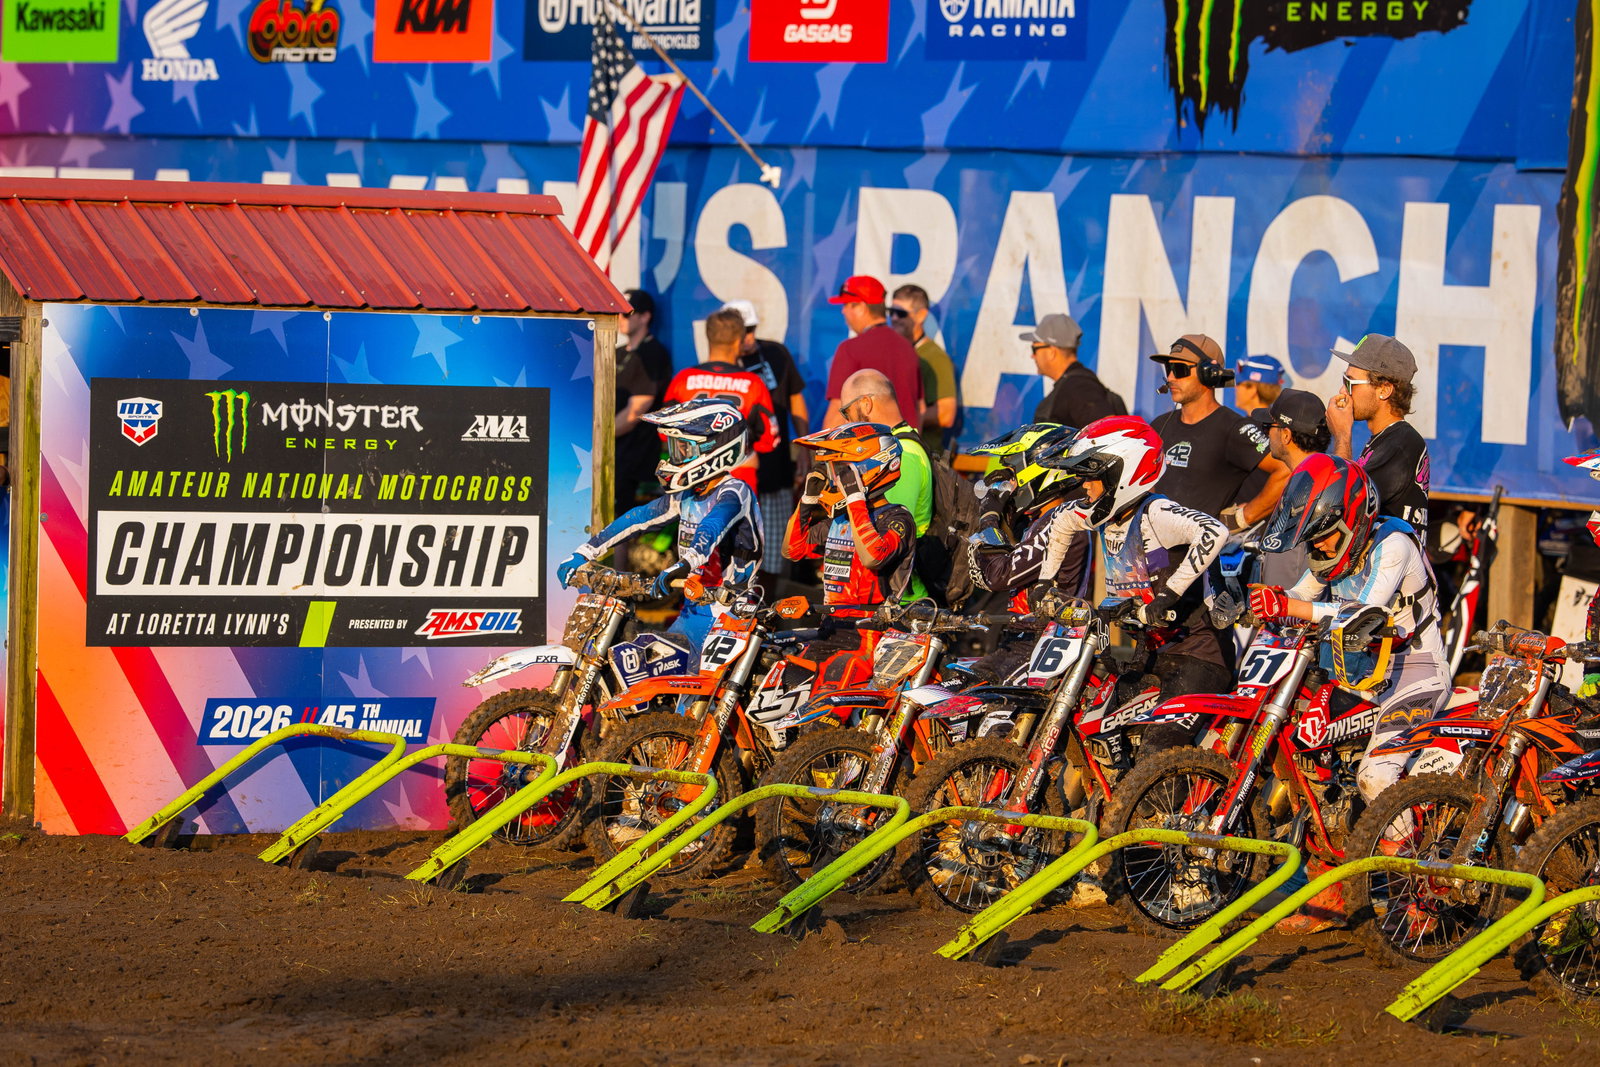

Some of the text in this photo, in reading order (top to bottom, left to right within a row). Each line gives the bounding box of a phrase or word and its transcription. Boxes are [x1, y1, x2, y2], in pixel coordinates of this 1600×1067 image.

[15, 0, 106, 34] Kawasaki
[957, 0, 1076, 19] YAMAHA
[1286, 1, 1430, 22] ENERGY
[783, 25, 853, 44] GASGAS
[949, 25, 1067, 38] RACING
[270, 47, 338, 62] MOTO
[141, 58, 219, 82] HONDA
[855, 184, 1542, 446] RANCH
[686, 374, 752, 394] OSBORNE
[119, 402, 161, 415] MX
[260, 397, 424, 433] MONSTER
[461, 414, 530, 438] AMA
[285, 437, 399, 451] ENERGY
[1166, 444, 1192, 464] 42
[687, 448, 736, 486] FXR
[109, 470, 533, 502] AMATEUR NATIONAL MOTOCROSS
[105, 520, 529, 588] CHAMPIONSHIP
[106, 613, 290, 635] AT LORETTA LYNN'S
[348, 619, 408, 630] PRESENTED BY
[422, 610, 521, 638] AMSOIL
[535, 655, 559, 664] FXR
[701, 635, 738, 665] 42
[1029, 637, 1072, 673] 16
[1238, 649, 1290, 685] 51
[586, 670, 597, 689] LAB
[208, 704, 293, 739] 2026
[317, 704, 357, 730] 45
[362, 703, 382, 719] TH
[359, 719, 423, 738] ANNUAL
[1439, 726, 1492, 737] ROOST
